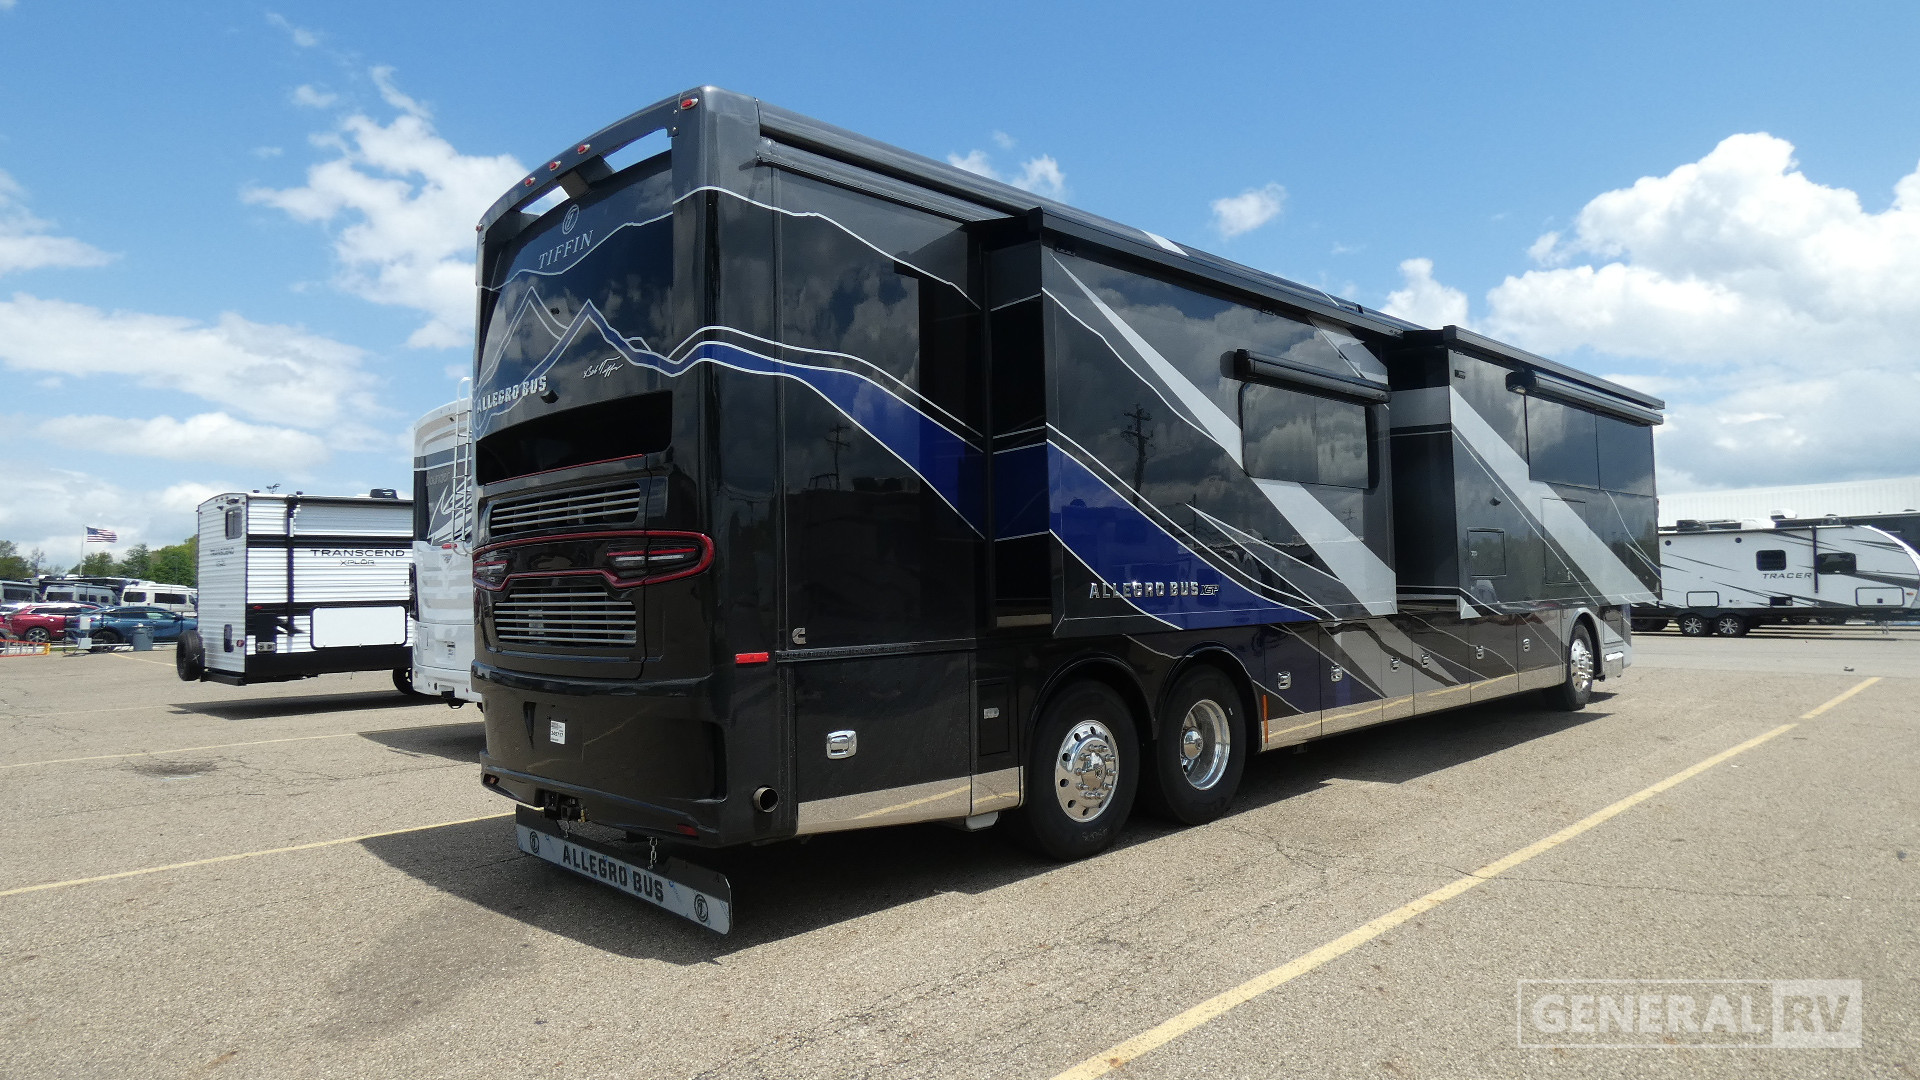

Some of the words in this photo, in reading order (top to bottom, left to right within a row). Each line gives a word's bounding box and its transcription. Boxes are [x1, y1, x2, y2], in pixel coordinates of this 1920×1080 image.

[538, 230, 594, 269] TIFFIN
[476, 384, 520, 413] ALLEGRO
[521, 375, 547, 398] BUS
[310, 549, 405, 557] TRANSCEND
[1089, 581, 1165, 599] ALLEGRO
[1169, 581, 1199, 597] BUS
[562, 844, 628, 887] ALLEGRO
[632, 870, 664, 902] BUS
